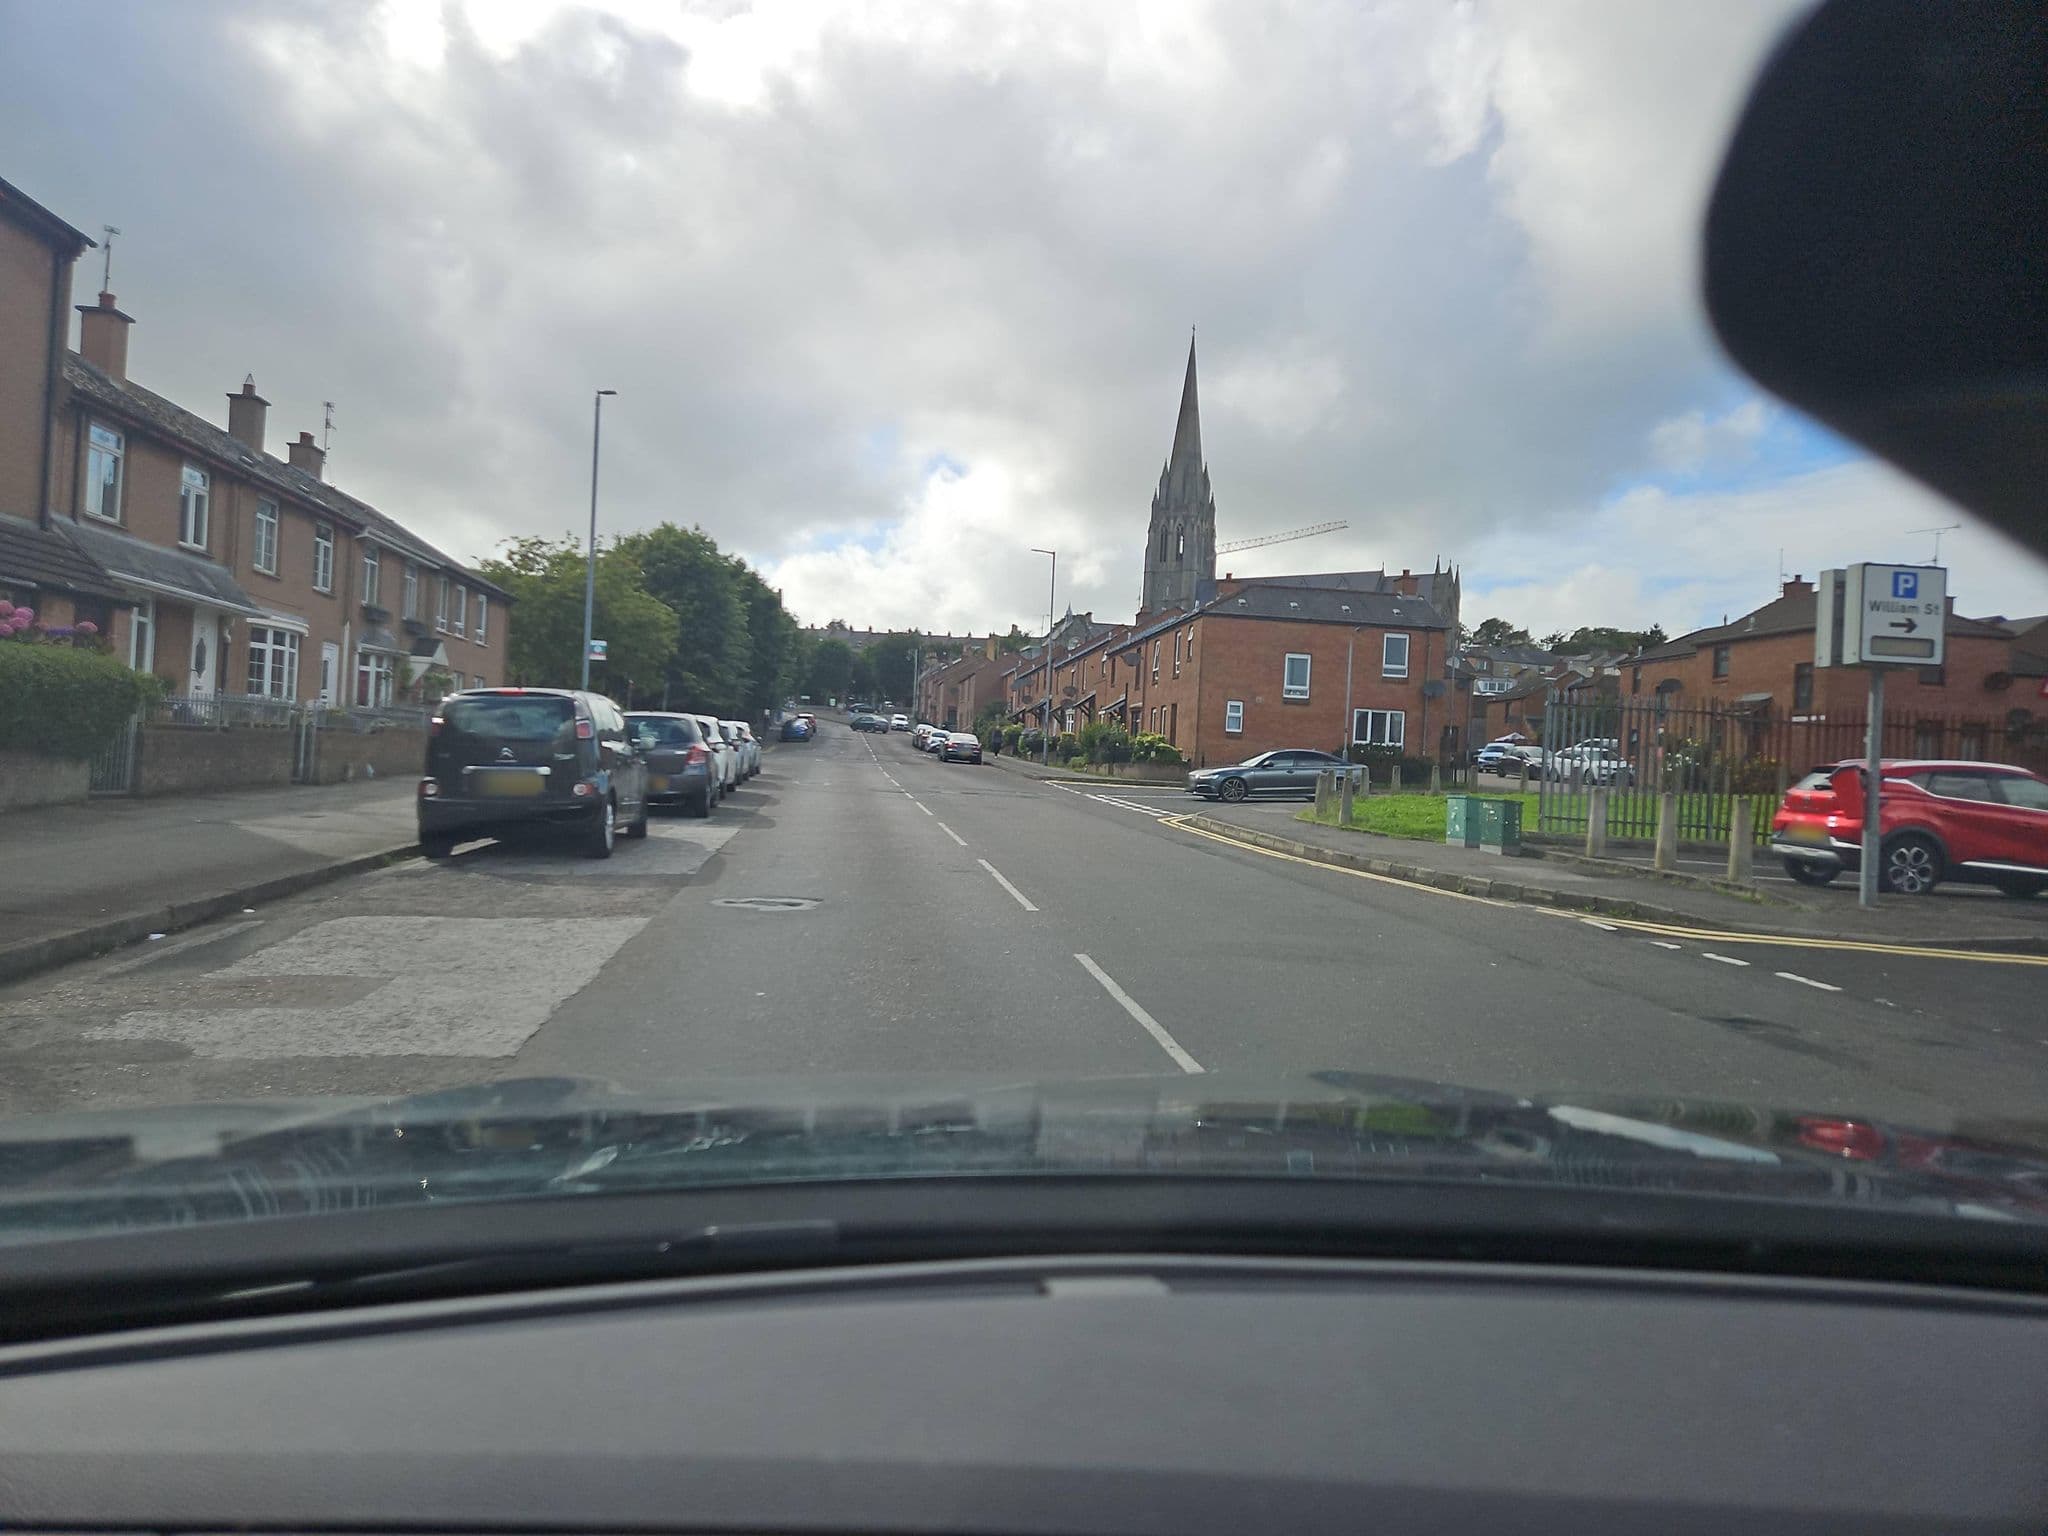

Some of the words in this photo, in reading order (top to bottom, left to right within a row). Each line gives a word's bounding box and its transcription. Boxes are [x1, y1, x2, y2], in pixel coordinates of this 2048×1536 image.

[1898, 574, 1915, 596] P
[1869, 600, 1919, 614] William
[1924, 603, 1940, 616] St
